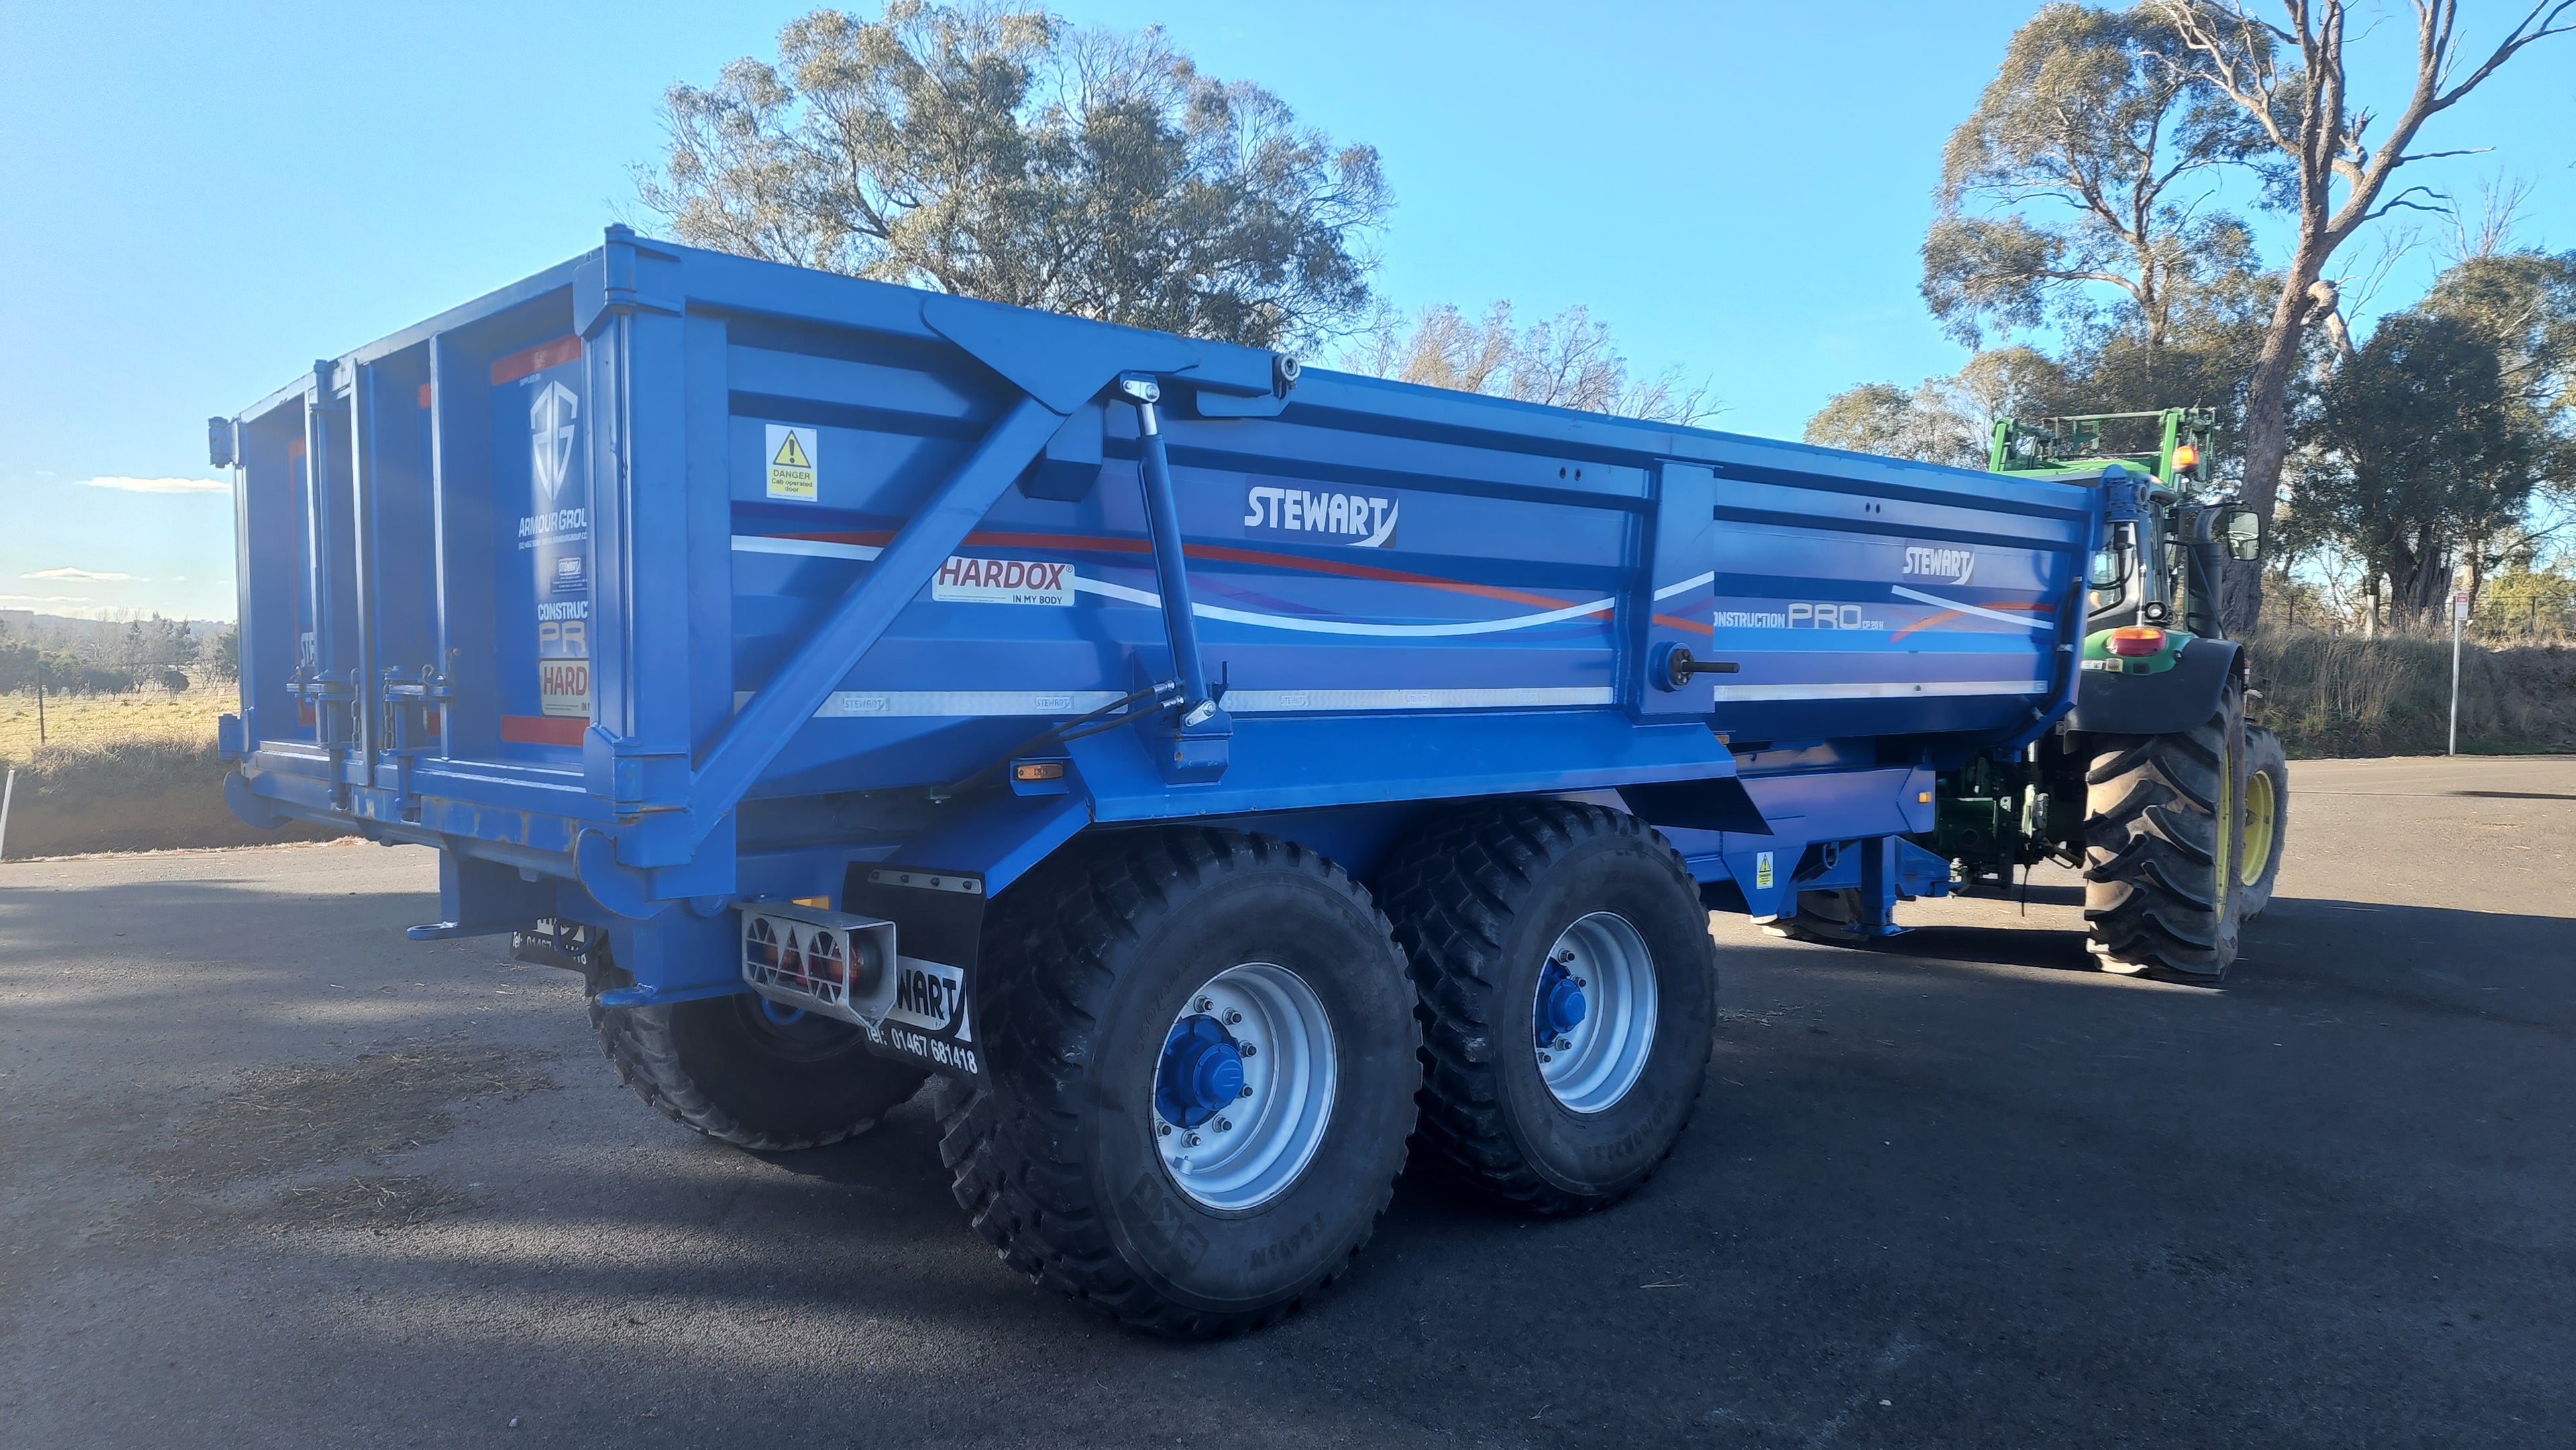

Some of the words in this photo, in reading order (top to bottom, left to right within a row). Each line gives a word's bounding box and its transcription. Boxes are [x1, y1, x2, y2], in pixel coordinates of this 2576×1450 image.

[773, 469, 810, 480] DANGER
[786, 480, 813, 488] operated
[1244, 486, 1399, 548] STEWART
[1902, 546, 1975, 585] STEWART
[537, 600, 588, 621] CONSTRUC
[1012, 594, 1022, 603] IN
[1024, 595, 1037, 604] MY
[1040, 596, 1063, 605] BODY
[1788, 602, 1862, 630] PRO
[543, 666, 590, 696] HARD
[891, 1027, 928, 1058] 01467
[930, 1038, 978, 1074] 681418
